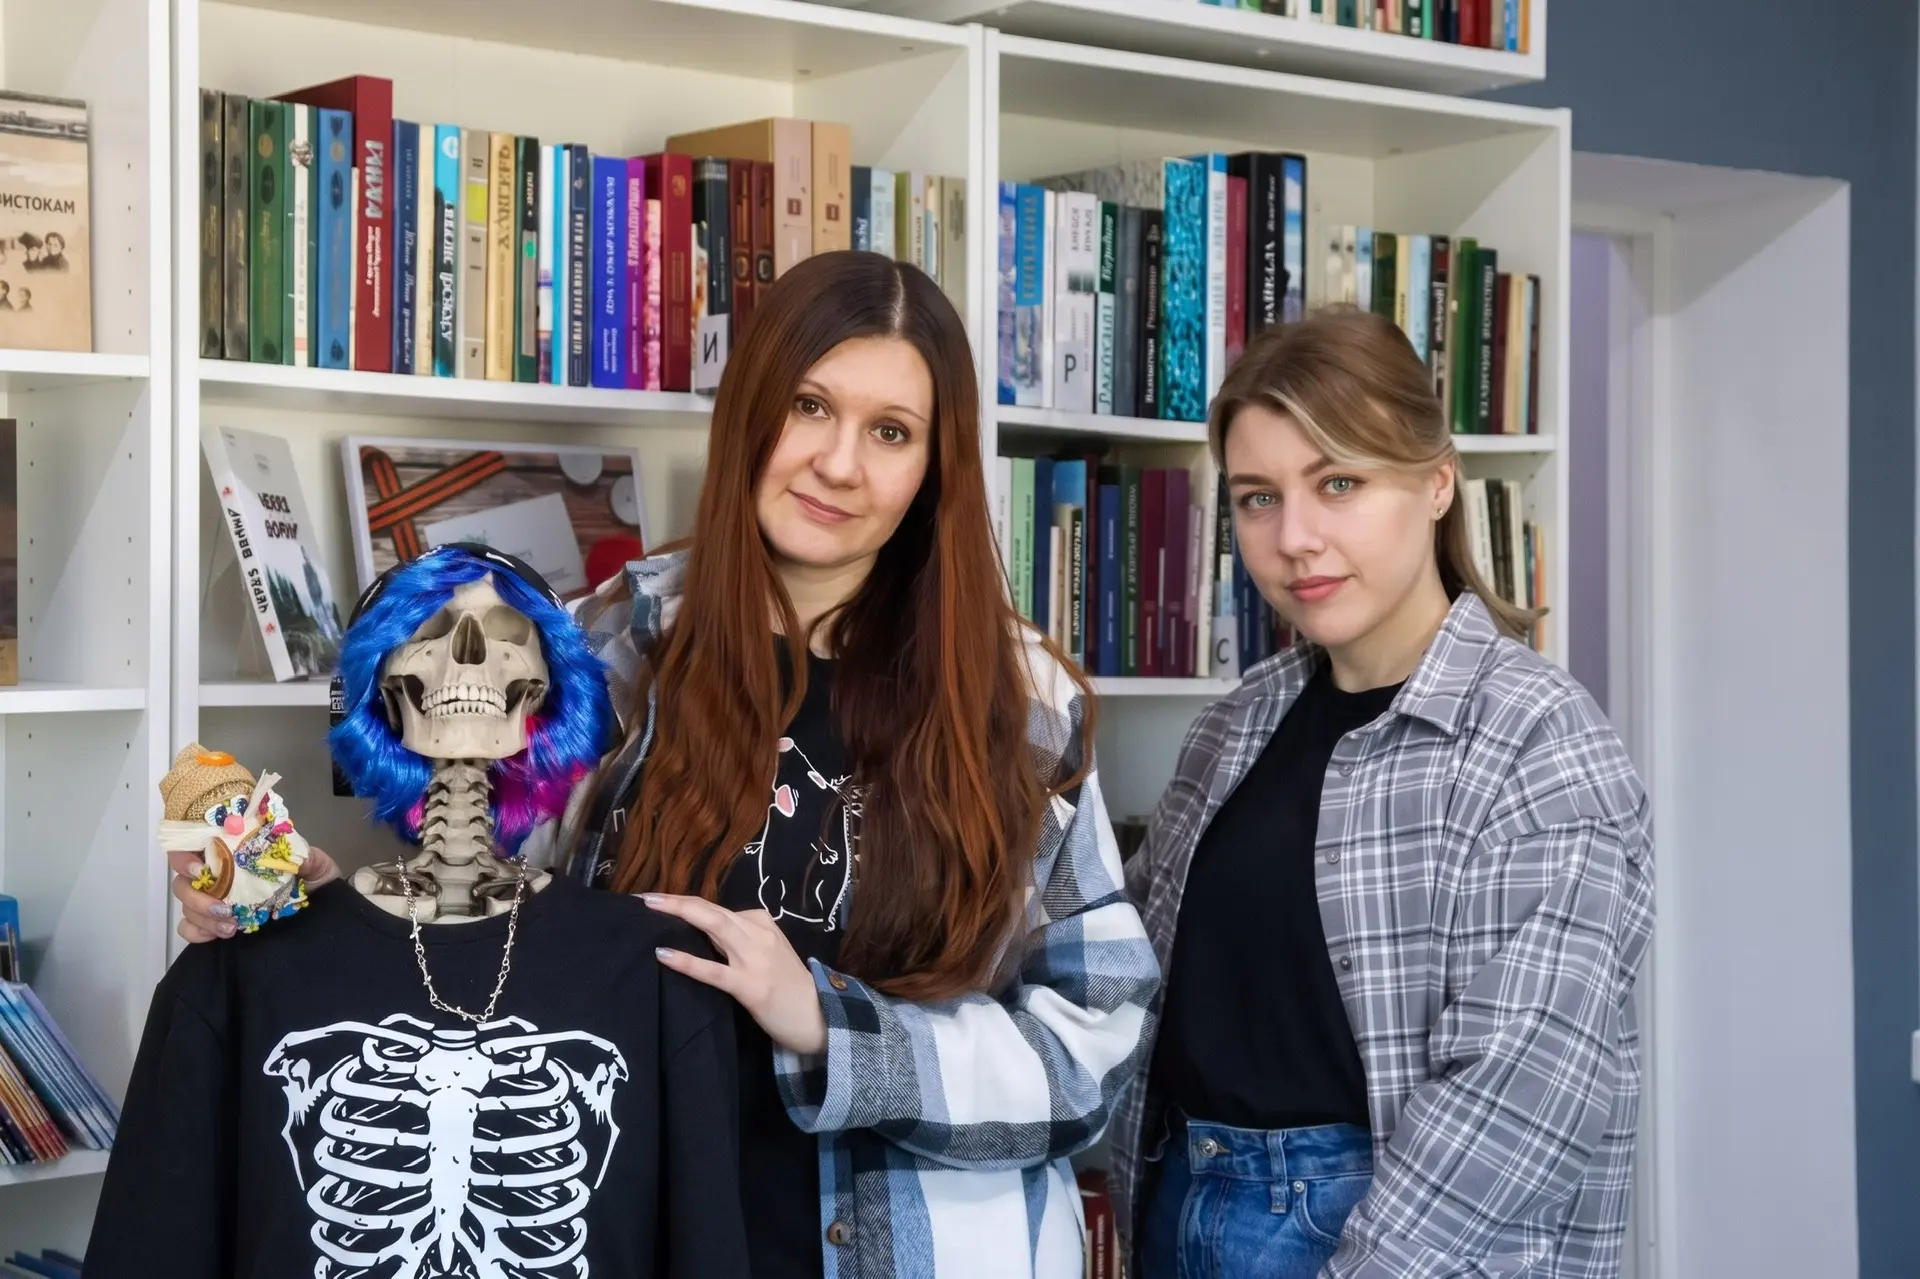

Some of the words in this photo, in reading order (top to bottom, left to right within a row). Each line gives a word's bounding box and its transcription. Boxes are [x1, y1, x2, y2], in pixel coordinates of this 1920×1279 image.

[703, 331, 718, 364] И
[1064, 353, 1077, 383] Р
[1215, 637, 1230, 664] С
